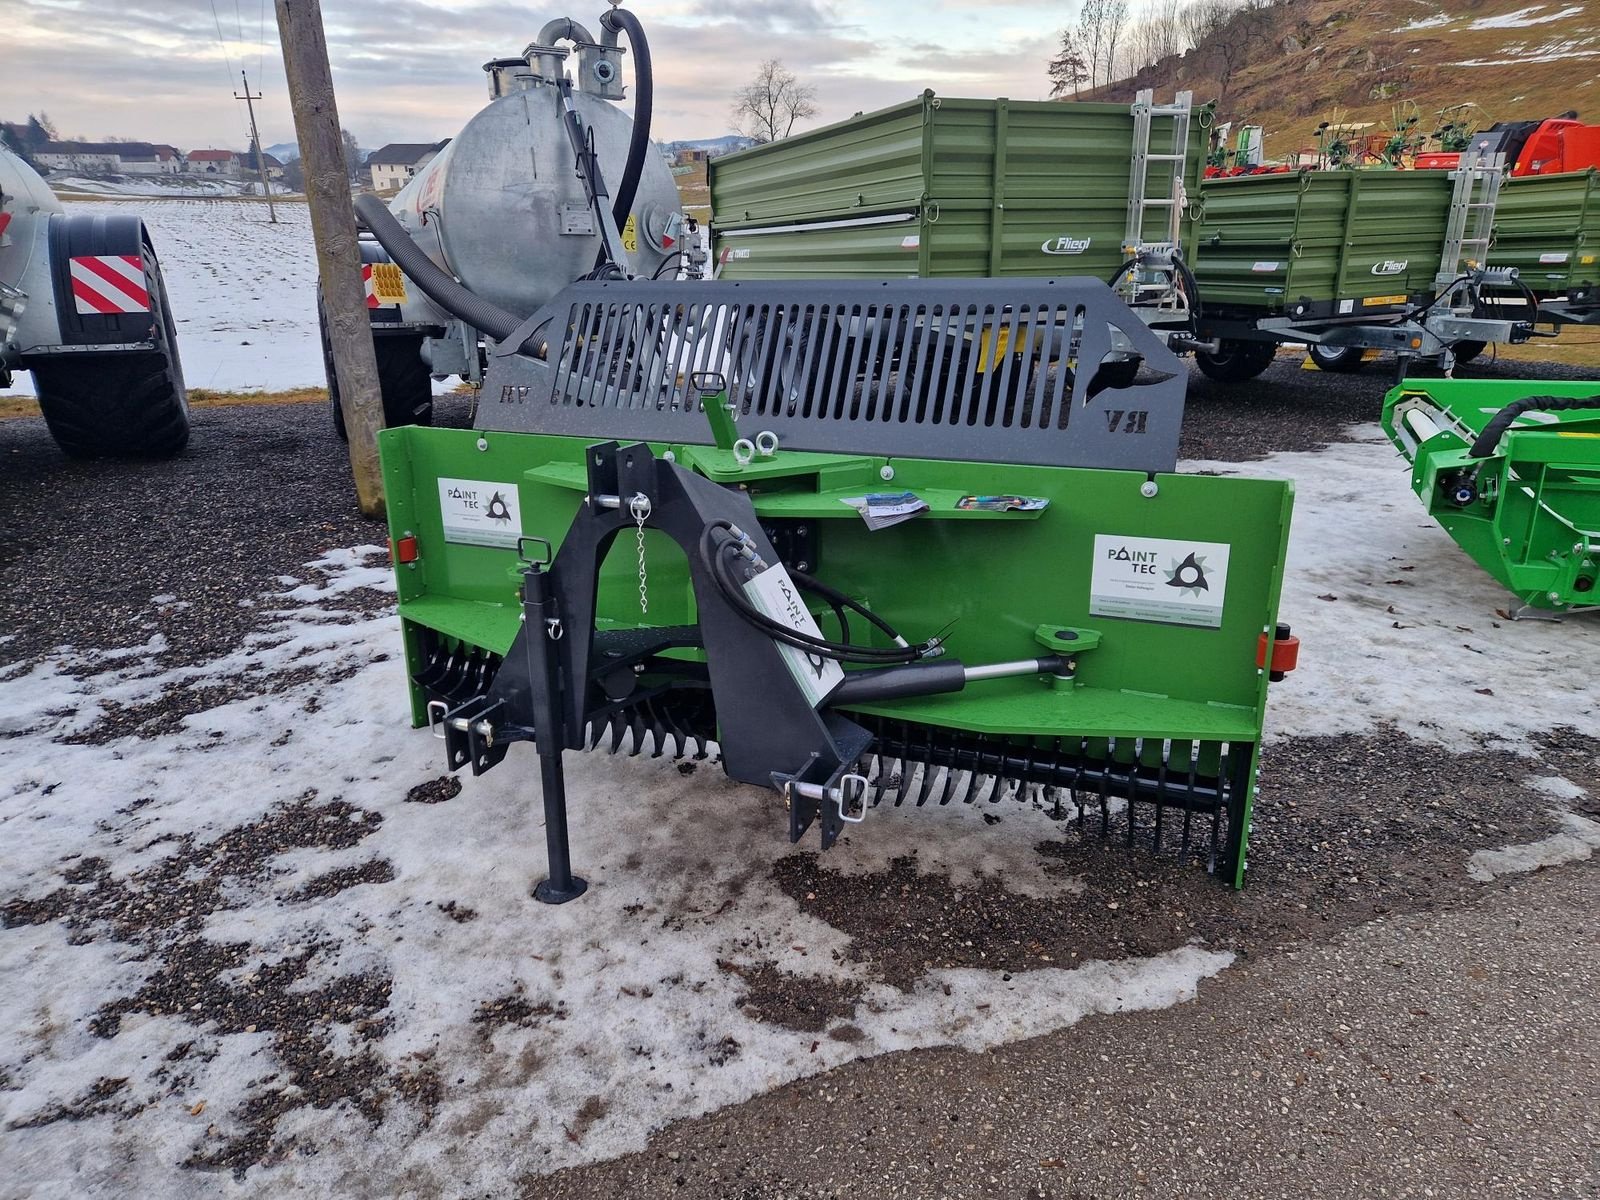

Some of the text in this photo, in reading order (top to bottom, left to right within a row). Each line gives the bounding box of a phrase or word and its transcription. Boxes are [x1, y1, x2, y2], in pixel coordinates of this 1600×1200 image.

[624, 240, 636, 250] CE
[1055, 236, 1091, 252] Fliegl
[1382, 259, 1408, 274] Fliegl
[463, 500, 479, 509] TEC
[1132, 563, 1157, 575] TEC
[786, 605, 802, 629] TEC
